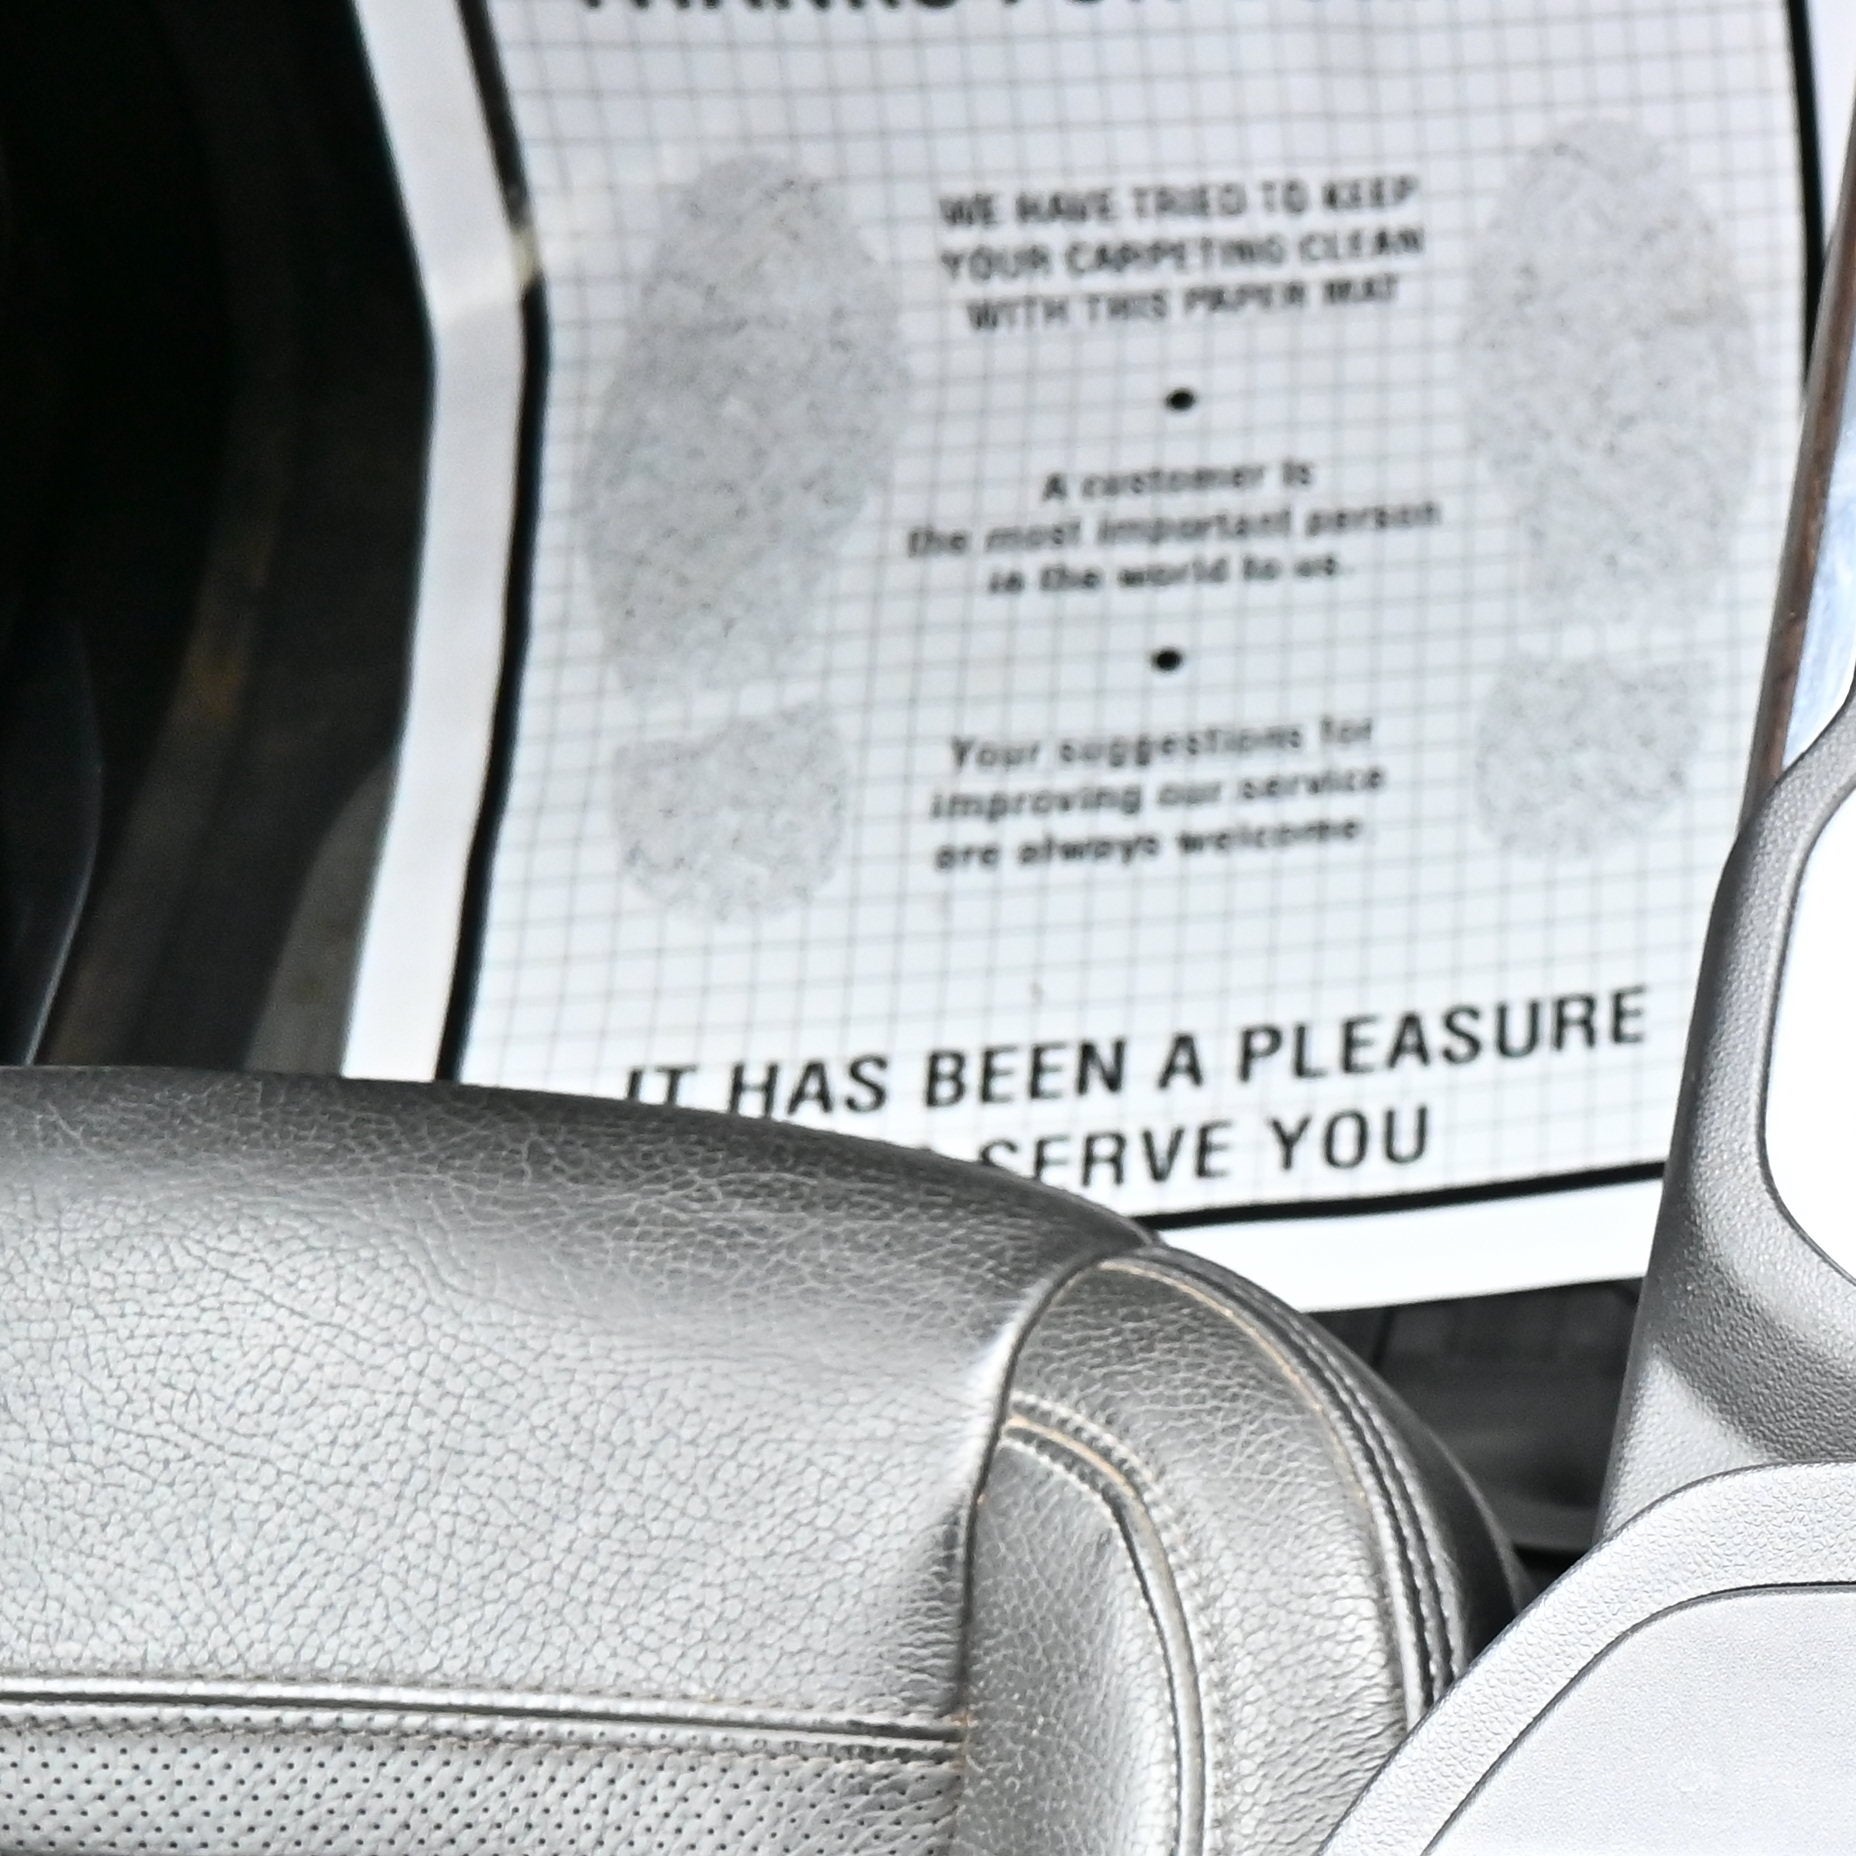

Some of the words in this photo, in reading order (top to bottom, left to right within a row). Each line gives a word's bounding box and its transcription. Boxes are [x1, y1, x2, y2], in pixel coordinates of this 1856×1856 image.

[940, 193, 995, 227] WE
[1016, 187, 1113, 224] HAVE
[1133, 183, 1248, 222] TRIED
[1261, 179, 1309, 213] TO
[1322, 175, 1420, 210] KEEP
[940, 244, 1051, 281] YOUR
[1065, 234, 1286, 275] CARPETING
[1299, 227, 1425, 262] CLEAN
[968, 295, 1068, 330] WITH
[1084, 290, 1168, 326] THIS
[1184, 281, 1305, 315] PAPER
[1043, 472, 1068, 500] A
[1082, 464, 1264, 497] customer
[1281, 459, 1312, 487] is
[908, 525, 968, 558] the
[984, 519, 1080, 554] most
[1096, 505, 1291, 545] important
[1307, 500, 1441, 538] person
[1041, 563, 1104, 592] the
[1118, 555, 1229, 588] world
[1243, 554, 1281, 581] to
[952, 736, 1040, 768] Your
[1058, 723, 1302, 768] suggestions
[1320, 716, 1372, 743] for
[931, 783, 1142, 821] improving
[1238, 768, 1385, 798] service
[934, 845, 999, 870] are
[1017, 833, 1159, 865] always
[626, 1065, 697, 1107] IT
[727, 1054, 890, 1120] HAS
[926, 1036, 1127, 1108] BEEN
[1157, 1032, 1202, 1088] A
[1239, 985, 1648, 1082] PLEASURE
[1268, 1103, 1429, 1171] YOU
